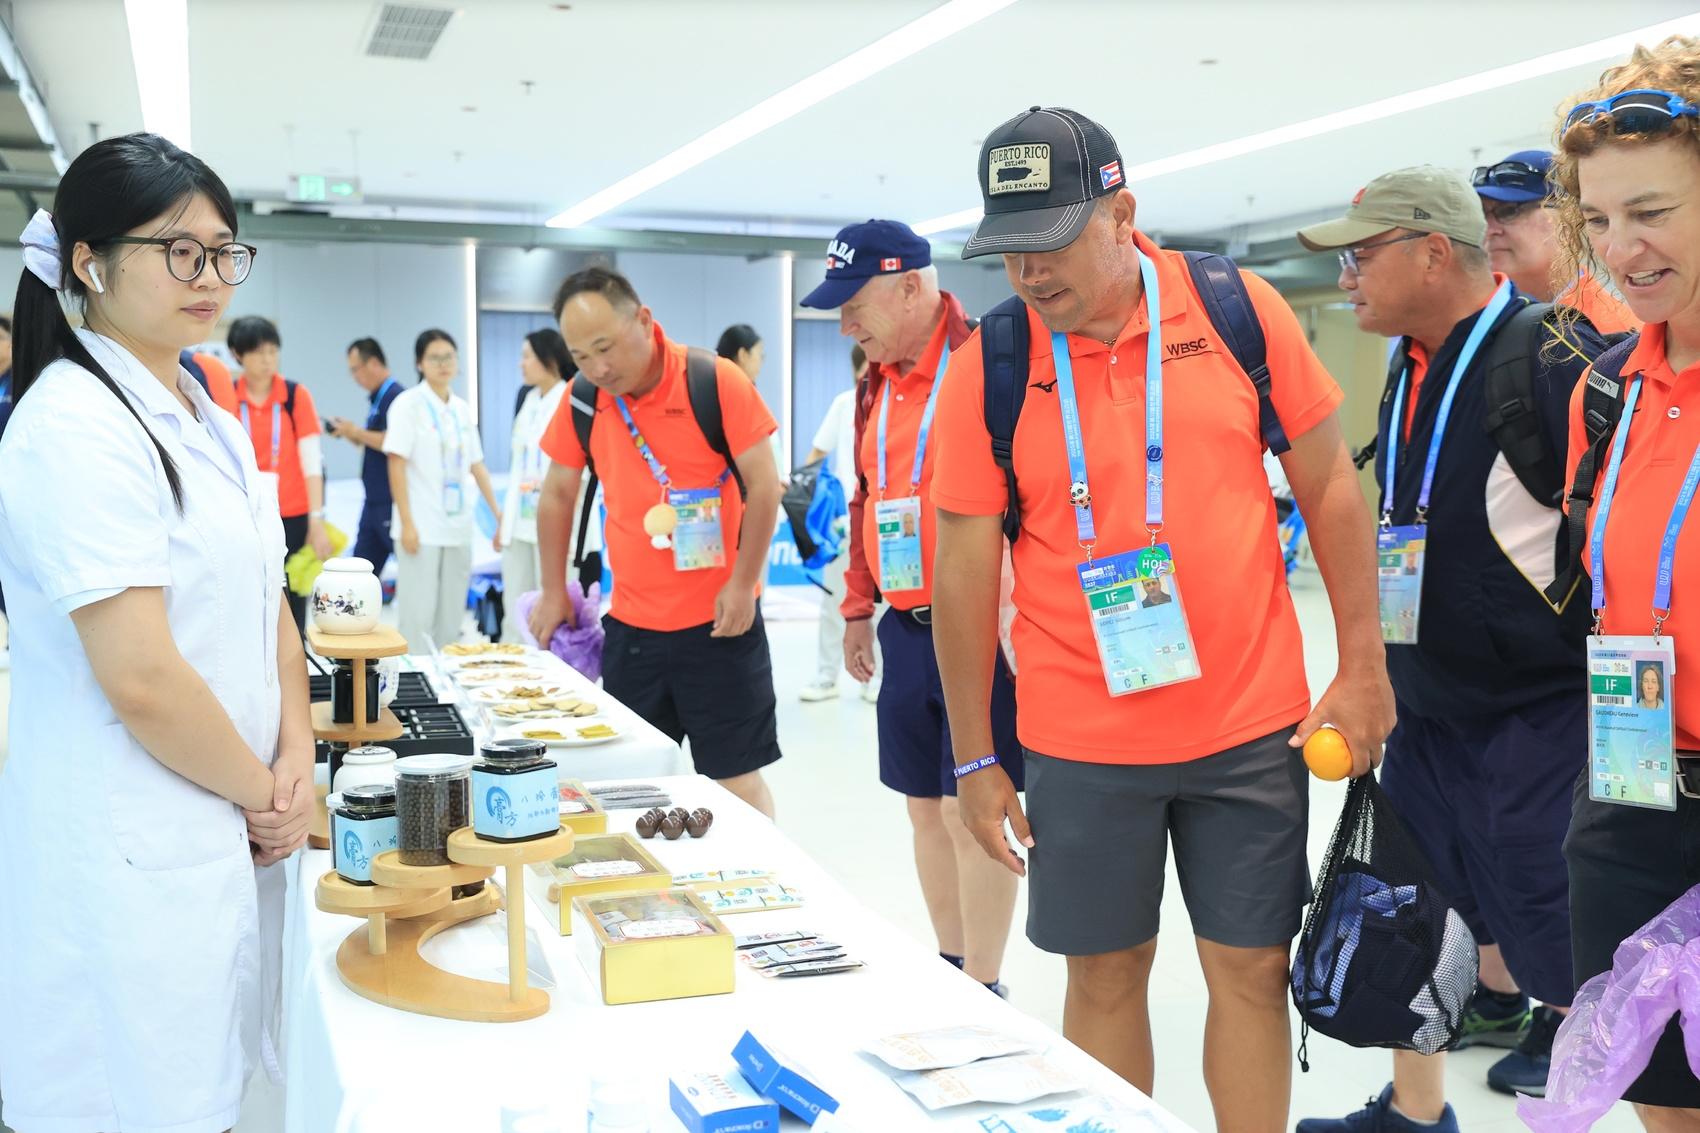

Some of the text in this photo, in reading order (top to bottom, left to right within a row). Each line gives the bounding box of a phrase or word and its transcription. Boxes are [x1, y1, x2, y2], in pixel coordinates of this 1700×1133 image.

[991, 145, 1049, 165] PUERTO RICO
[1166, 338, 1209, 356] WBSC
[1105, 591, 1118, 604] IF
[1124, 674, 1148, 688] C F
[1605, 678, 1617, 691] IF
[957, 756, 996, 776] PUERTO RICO
[1604, 783, 1627, 798] C F
